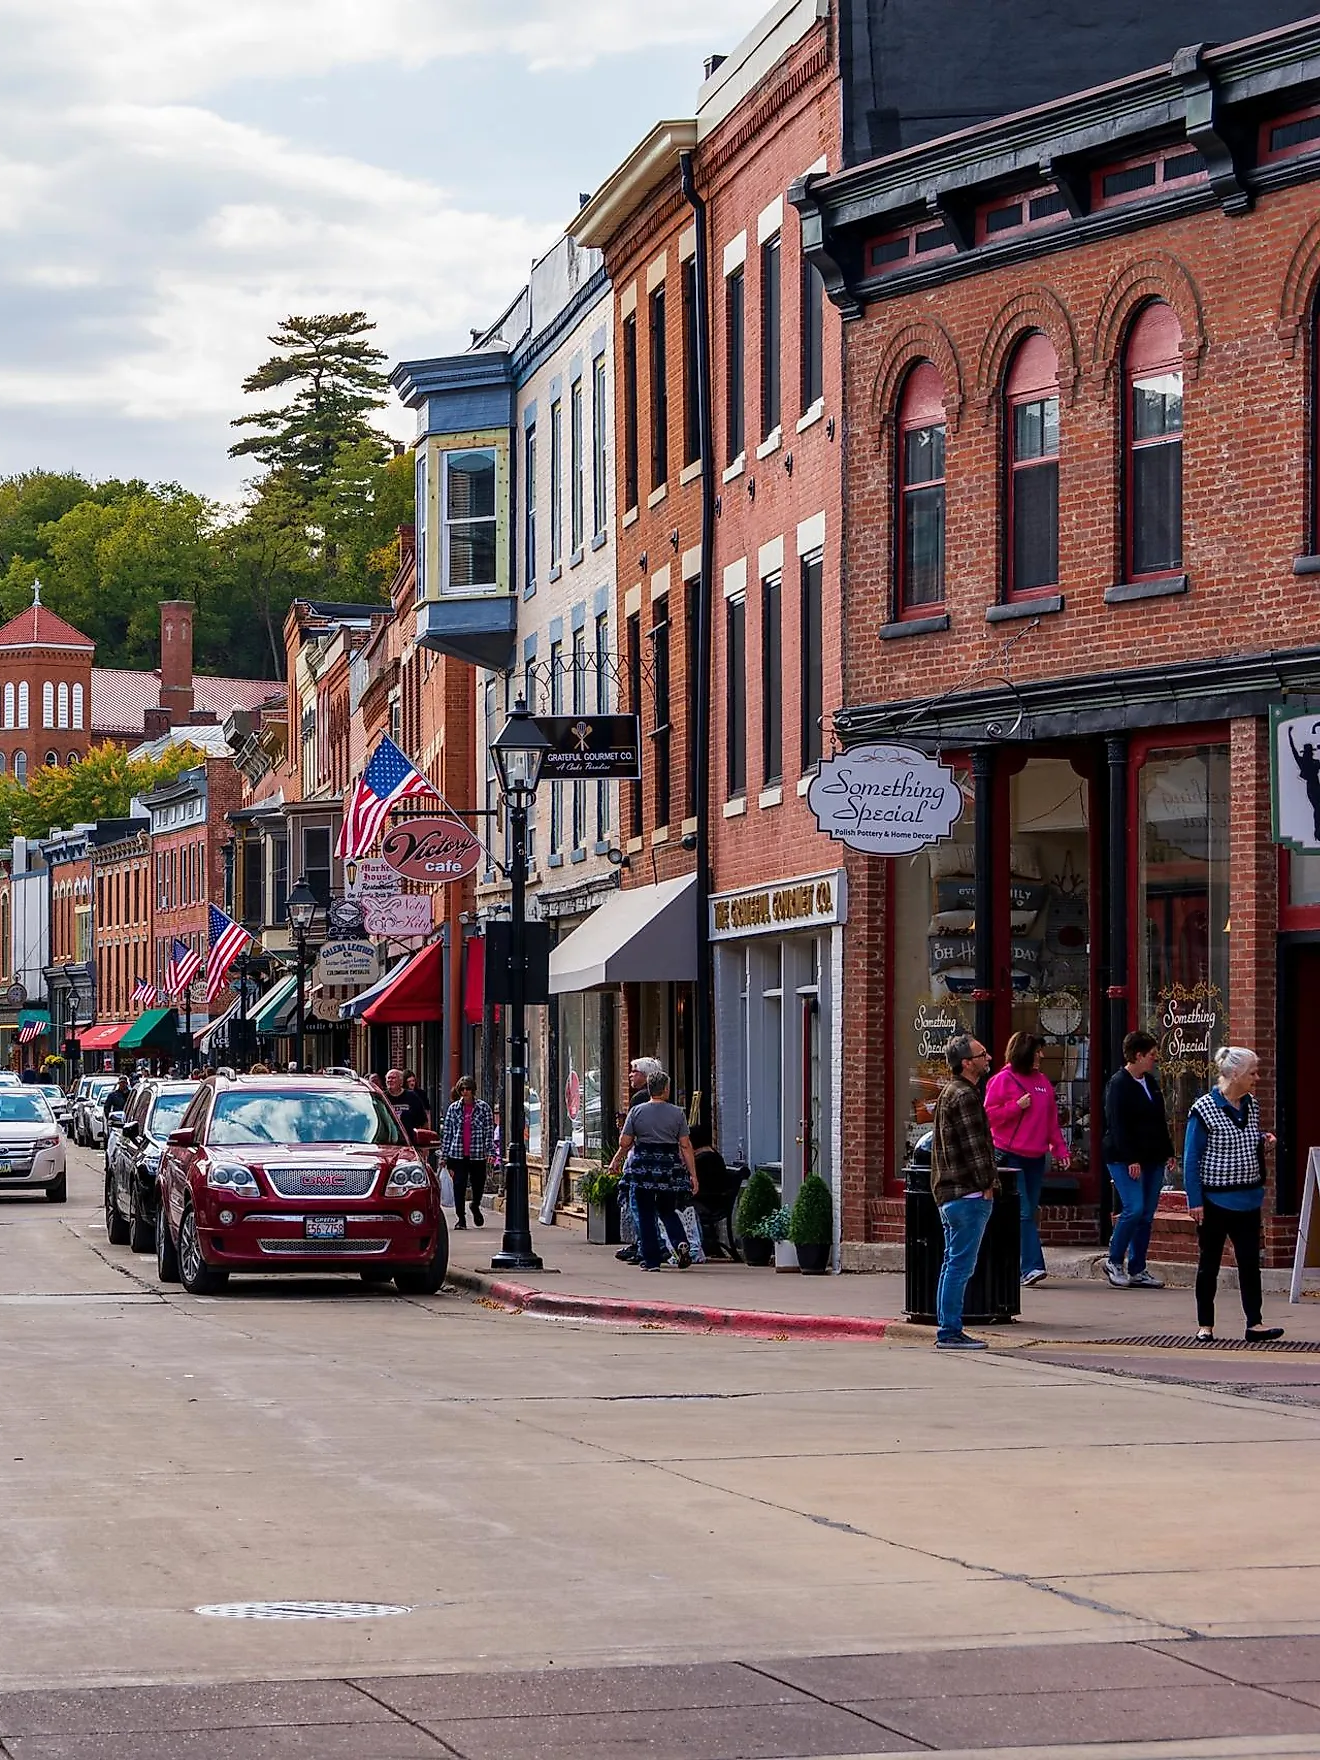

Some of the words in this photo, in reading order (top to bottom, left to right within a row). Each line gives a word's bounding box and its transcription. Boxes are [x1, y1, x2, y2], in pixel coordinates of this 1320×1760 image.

[547, 753, 582, 762] GRATEFUL
[584, 752, 618, 761] GOURMET
[620, 751, 634, 760] CO.
[821, 769, 945, 810] Something
[832, 795, 929, 829] Special
[834, 828, 856, 836] Polish
[857, 829, 883, 839] Pottery
[884, 830, 890, 838] &
[891, 831, 912, 839] Home
[913, 832, 934, 840] Decor
[384, 830, 479, 868] Victory
[425, 860, 463, 873] cafe
[731, 892, 771, 927] GRATEFUL
[773, 884, 815, 922] GOURMET
[914, 1005, 957, 1033] Something
[1163, 1000, 1216, 1029] Something
[1168, 1027, 1211, 1060] Special
[301, 1175, 346, 1186] GMC
